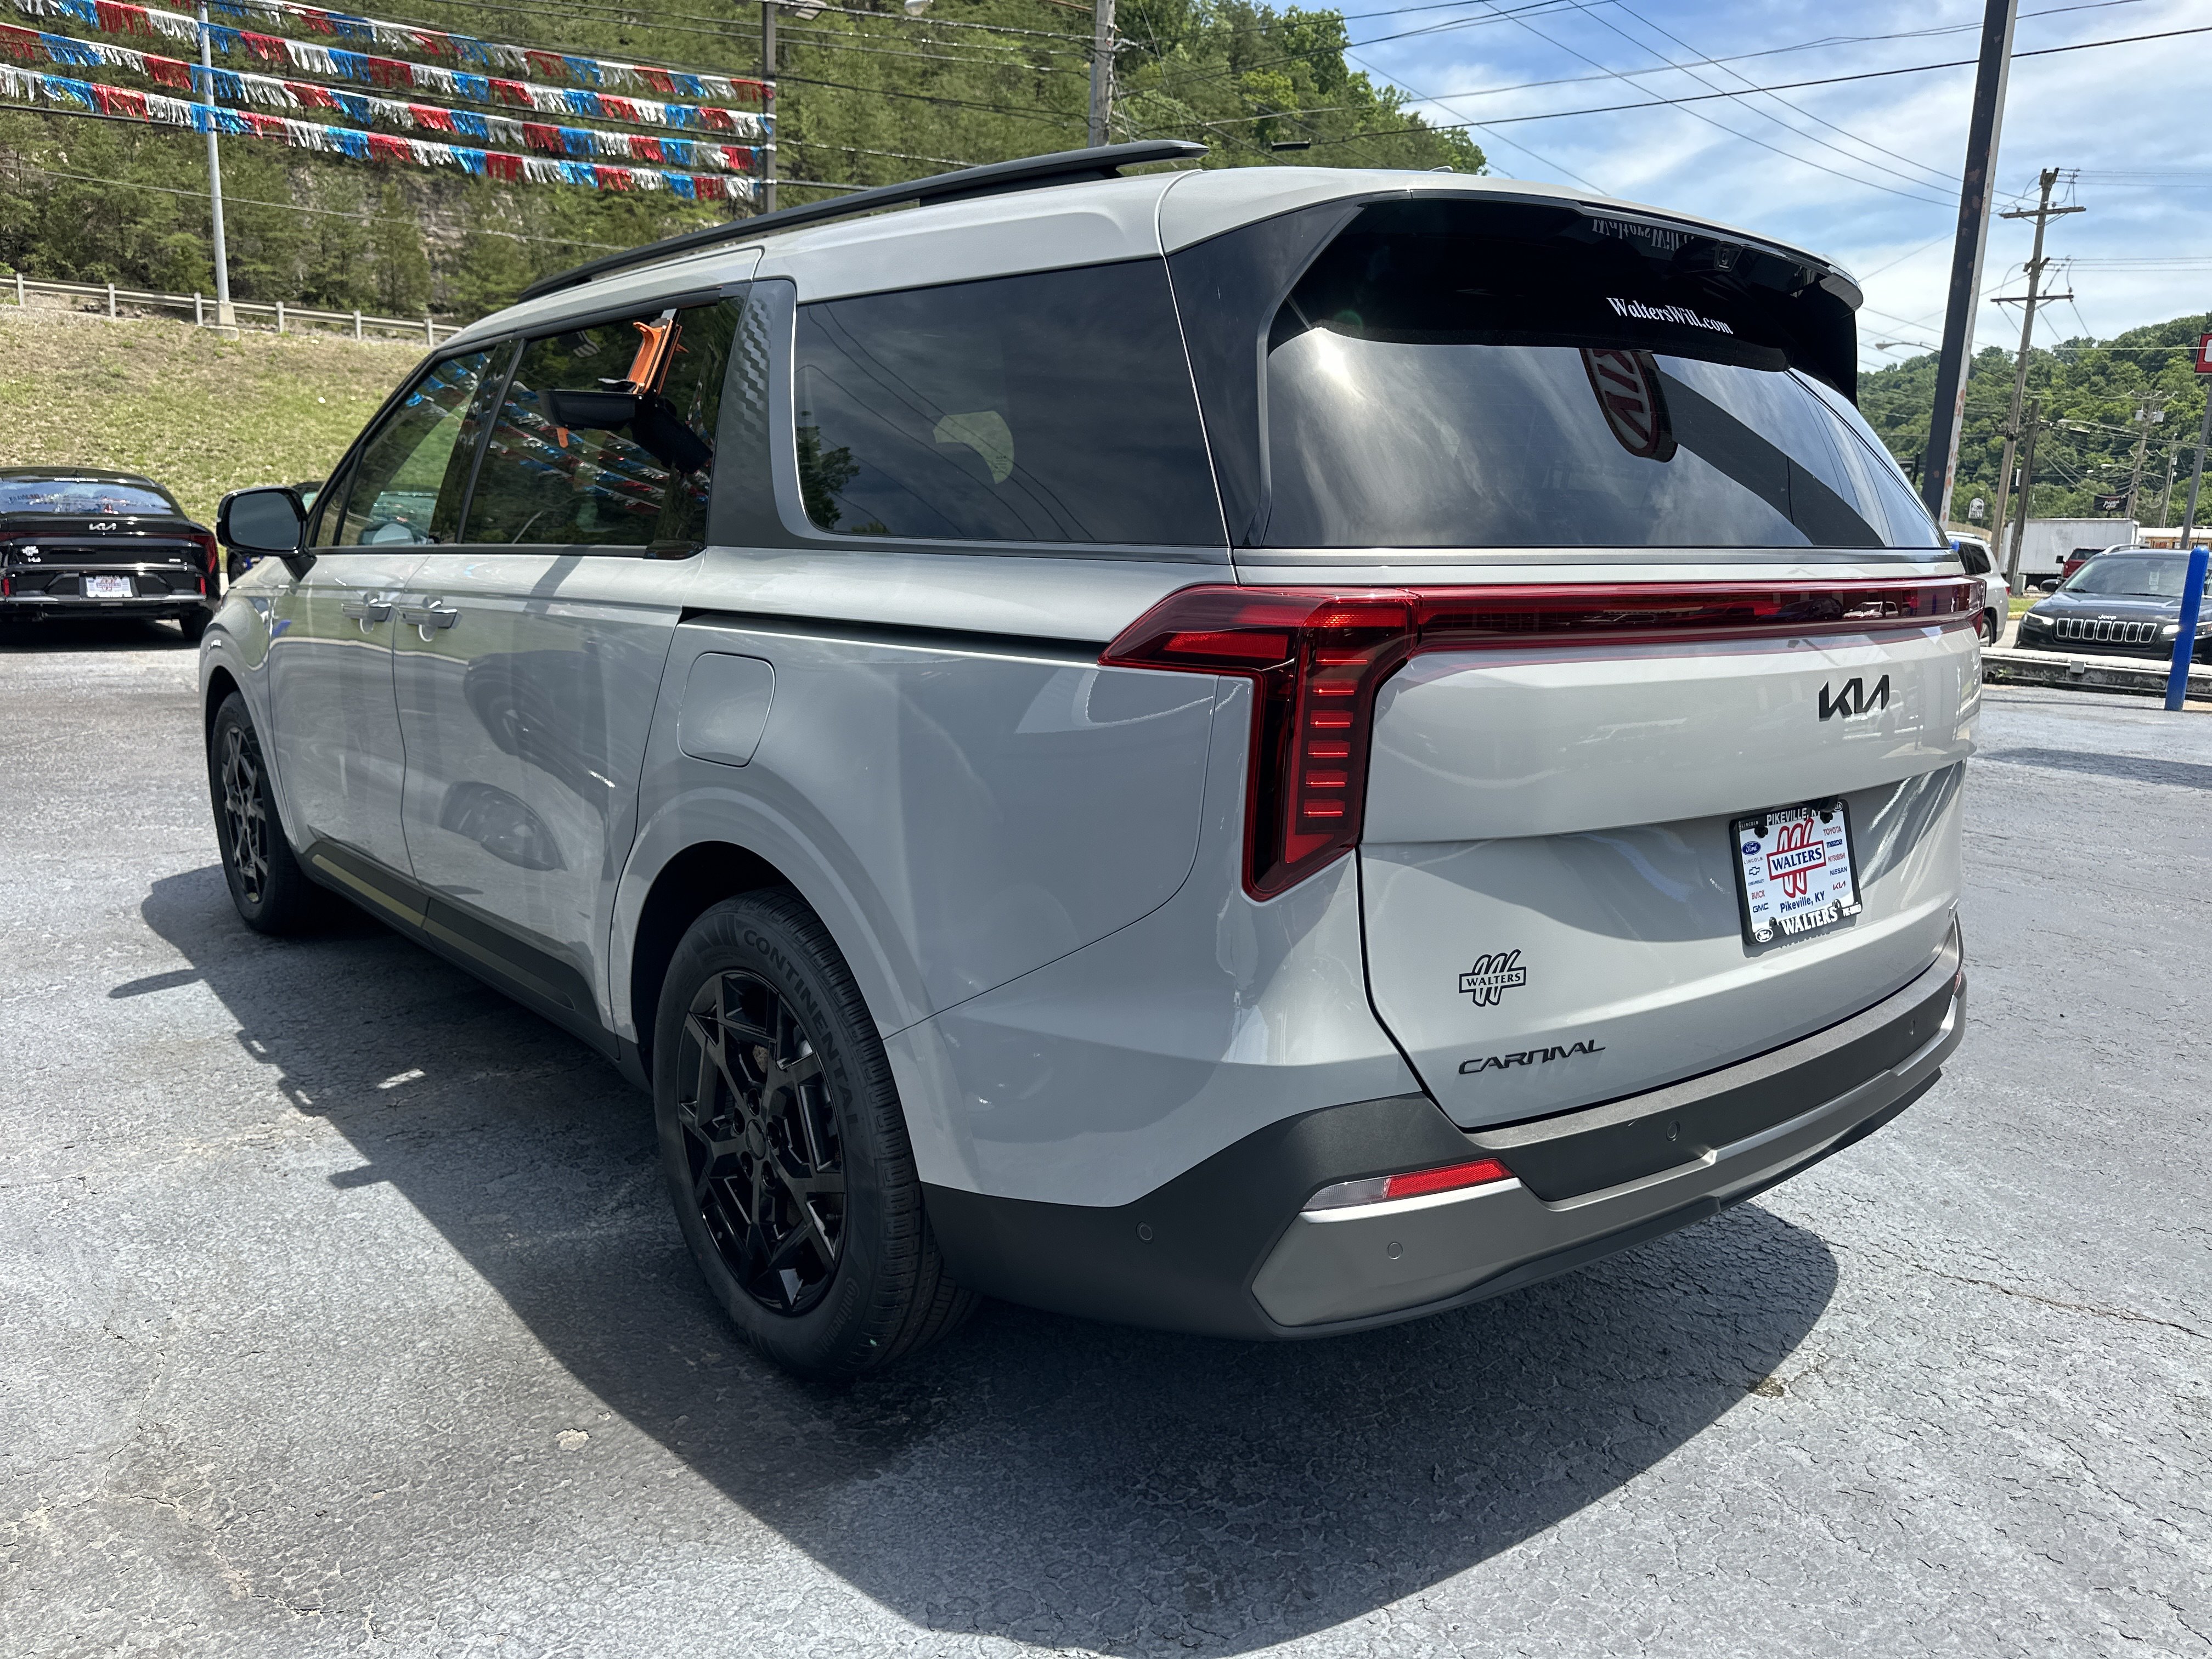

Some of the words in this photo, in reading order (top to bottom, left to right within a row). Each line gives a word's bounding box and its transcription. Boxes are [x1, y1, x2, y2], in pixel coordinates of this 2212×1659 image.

[1606, 297, 1734, 335] WaltersWill.com
[1819, 674, 1890, 722] KIA
[1767, 807, 1809, 826] PIKEVILLE,
[1812, 809, 1820, 817] K
[1823, 826, 1842, 836] TOYOTA
[1744, 843, 1759, 854] Ford
[1743, 856, 1763, 865] LINCOLN
[1771, 848, 1822, 871] WALTERS
[1828, 853, 1846, 863] MITSUBISHI
[1830, 866, 1848, 876] NISSAN
[1833, 881, 1846, 890] KIA
[1751, 890, 1765, 900] BUICK
[1780, 896, 1813, 913] Pikeville,
[1815, 890, 1825, 903] KY
[1752, 902, 1769, 913] GMC
[1781, 907, 1838, 935] WALTERS
[1466, 973, 1521, 986] WALTERS
[743, 929, 858, 1137] CONTINENTAL
[1459, 1039, 1606, 1075] CARNIVAL
